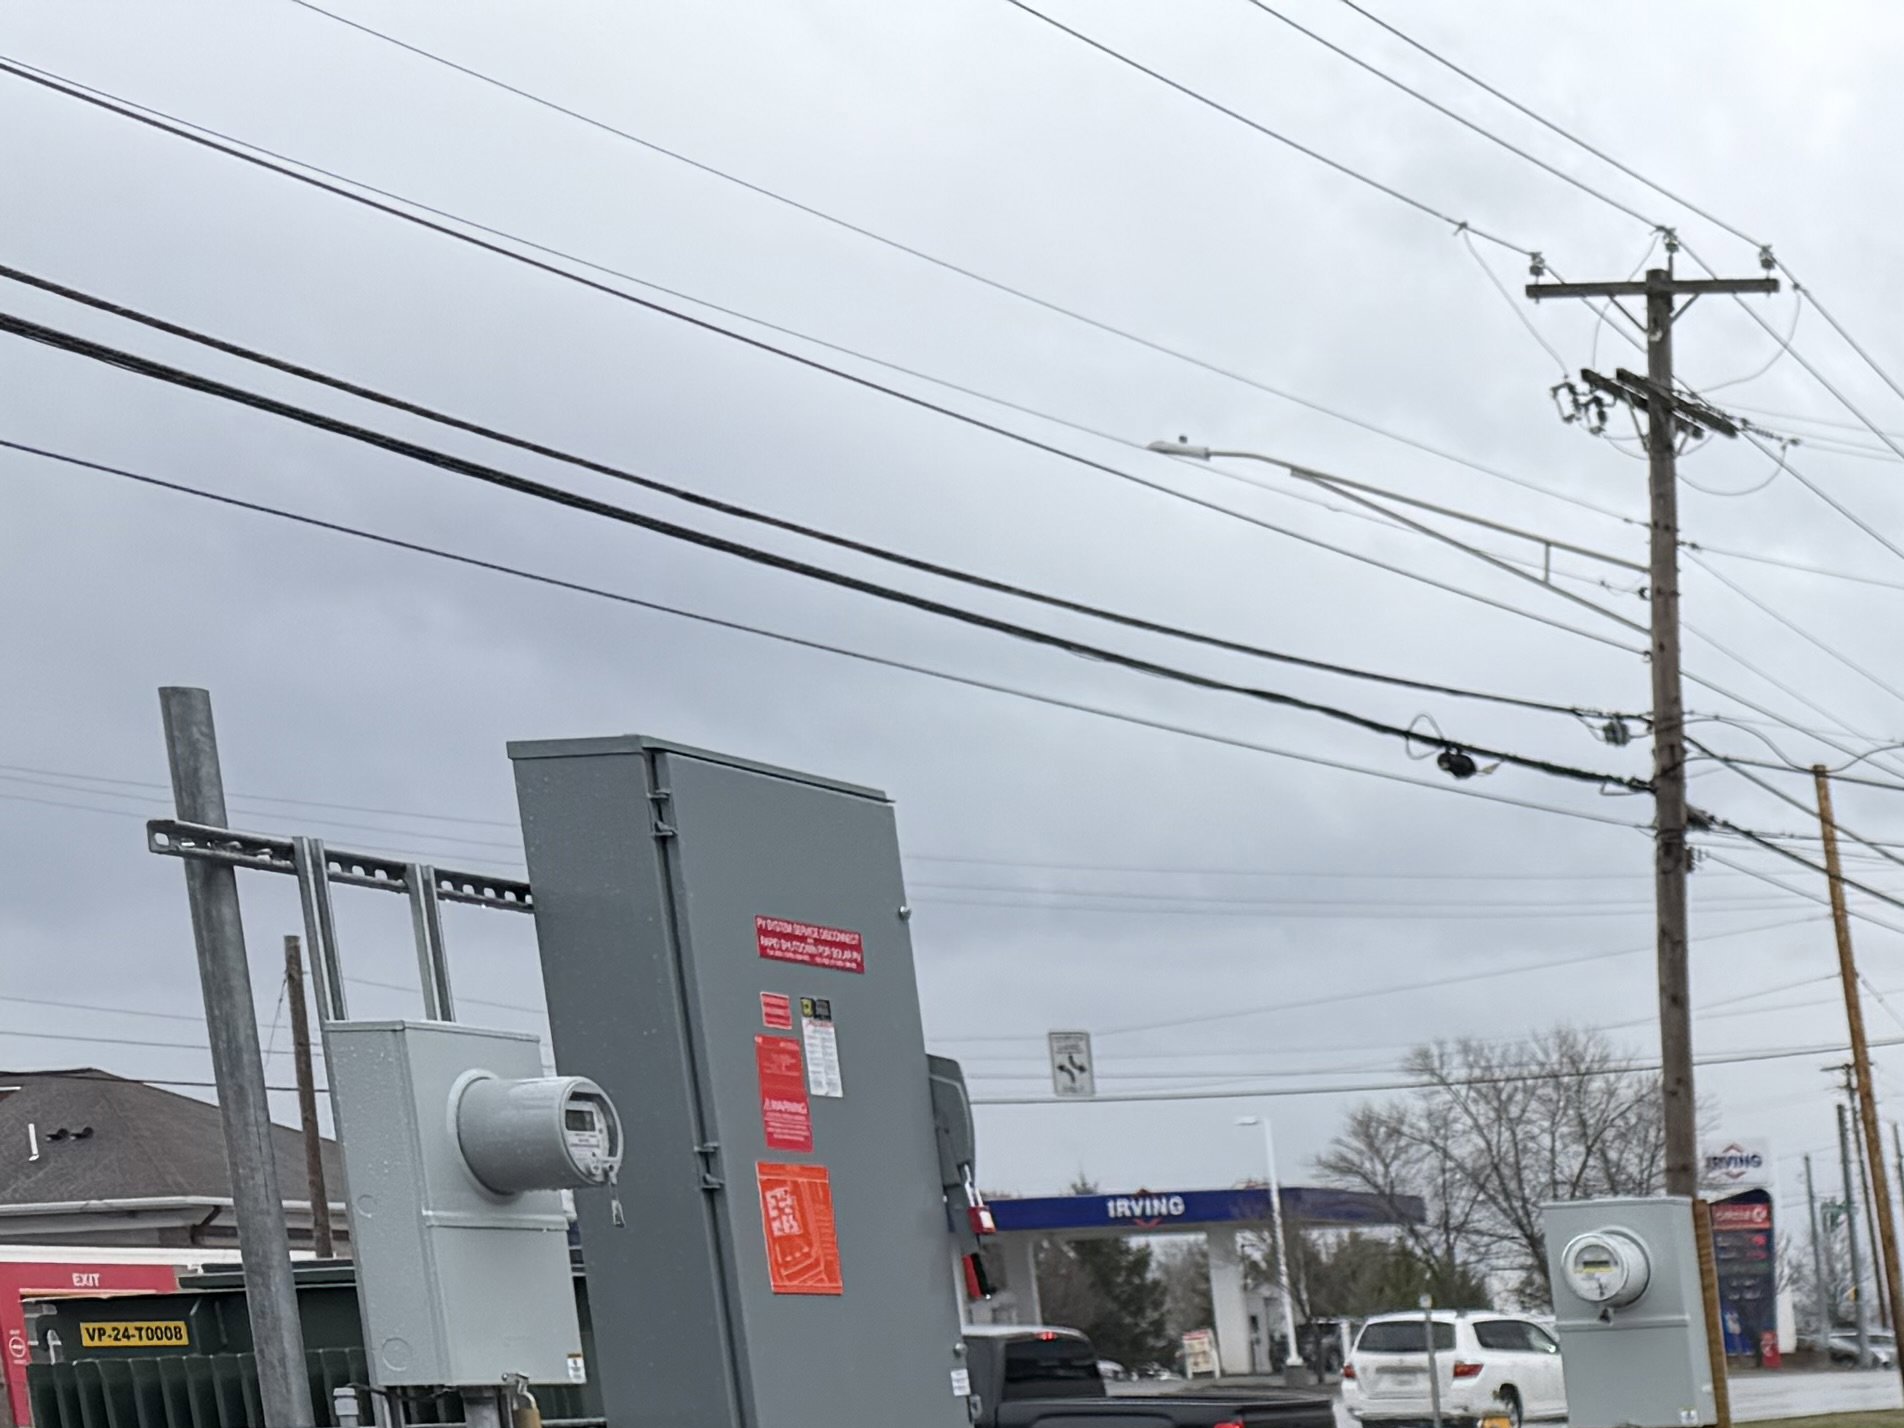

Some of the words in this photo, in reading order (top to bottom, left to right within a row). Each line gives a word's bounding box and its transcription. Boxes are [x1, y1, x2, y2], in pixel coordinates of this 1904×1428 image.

[1107, 1195, 1185, 1218] IRVING
[72, 1272, 100, 1287] EXIT
[85, 1326, 184, 1343] VP-24-T0008
